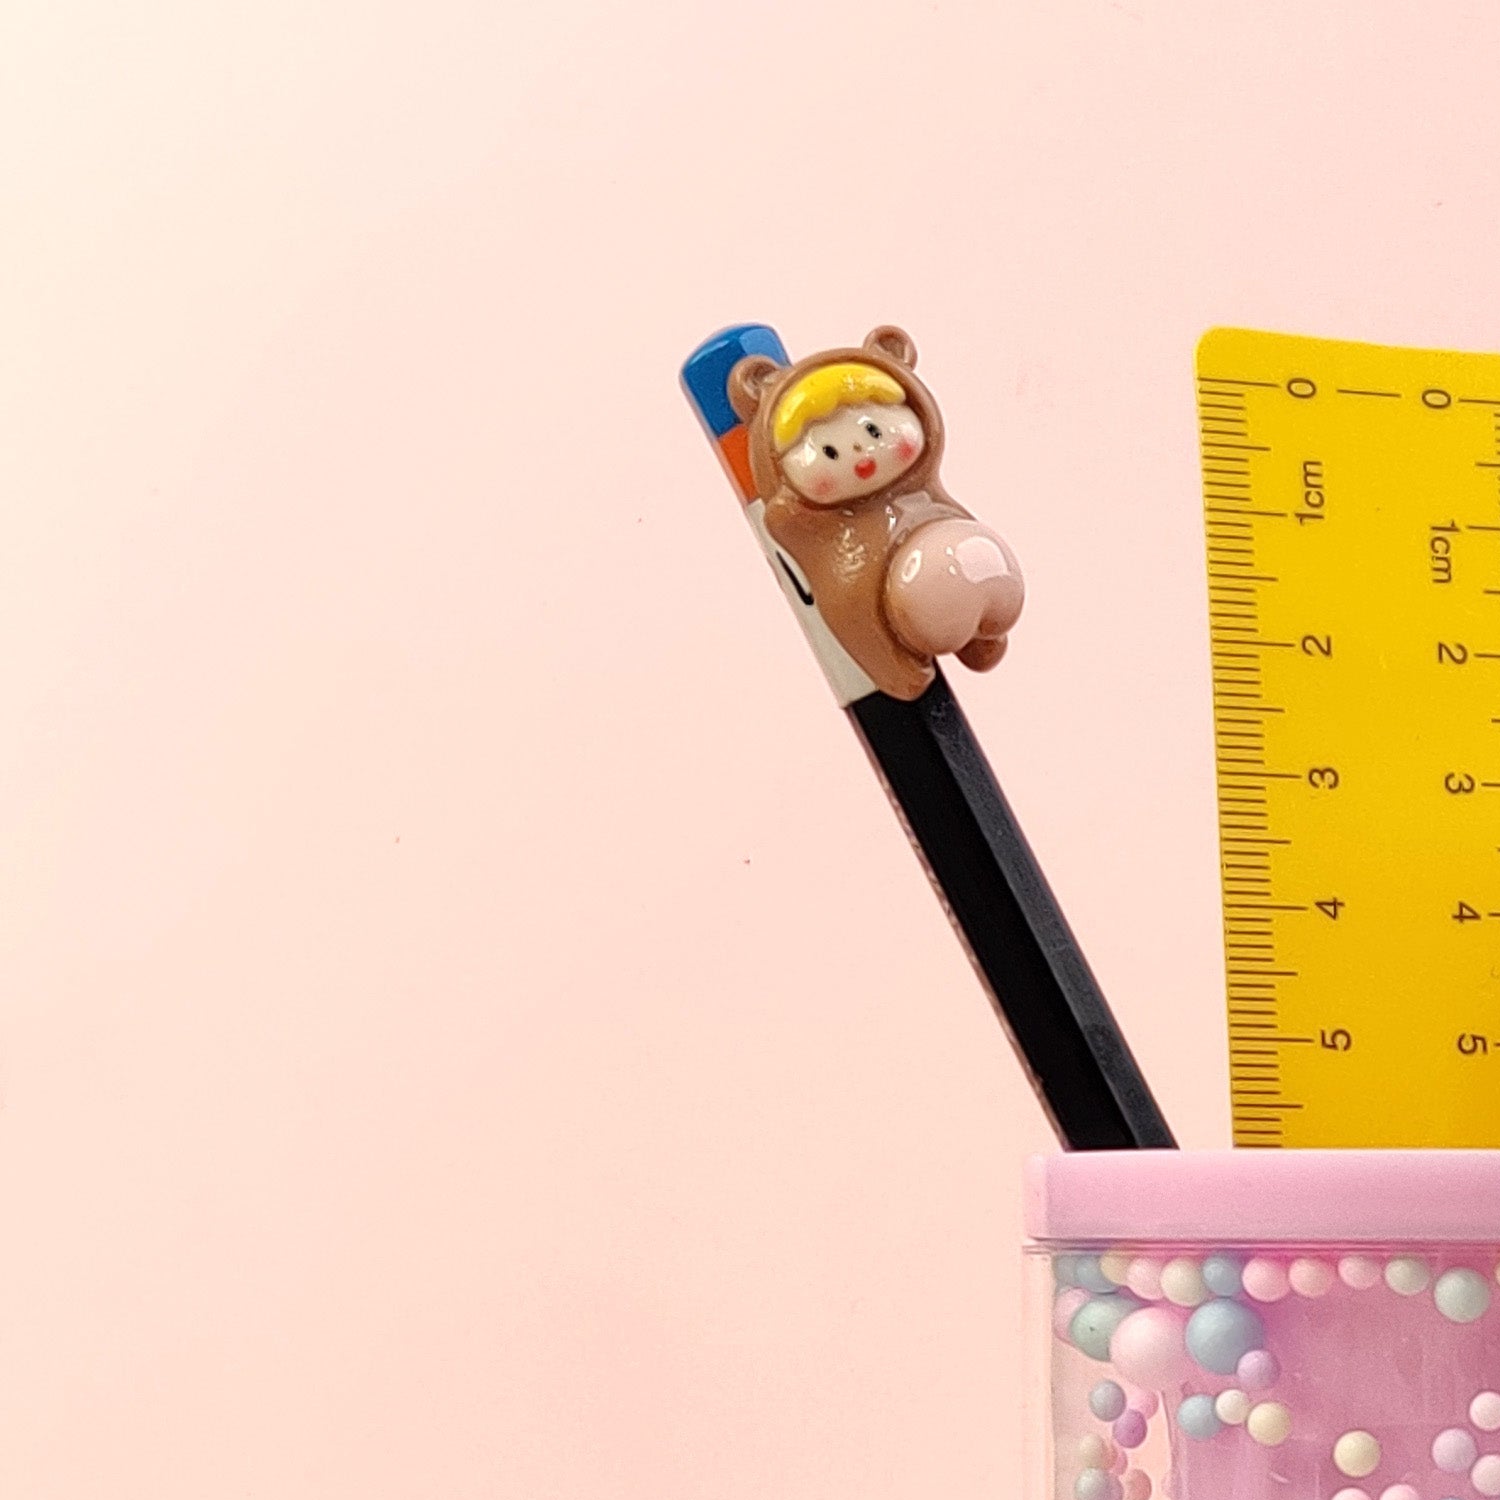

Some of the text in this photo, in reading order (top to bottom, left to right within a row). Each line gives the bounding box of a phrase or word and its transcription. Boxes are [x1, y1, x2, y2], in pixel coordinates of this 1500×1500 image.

[1286, 378, 1317, 399] 0
[1422, 389, 1451, 410] 0
[1294, 461, 1324, 525] 1cm
[1430, 520, 1460, 583] 1cm
[1301, 635, 1332, 657] 2
[1438, 642, 1468, 665] 2
[1308, 767, 1339, 789] 3
[1444, 772, 1475, 795] 3
[1315, 897, 1345, 920] 4
[1452, 901, 1481, 924] 4
[1321, 1029, 1352, 1051] 5
[1457, 1033, 1487, 1055] 5
